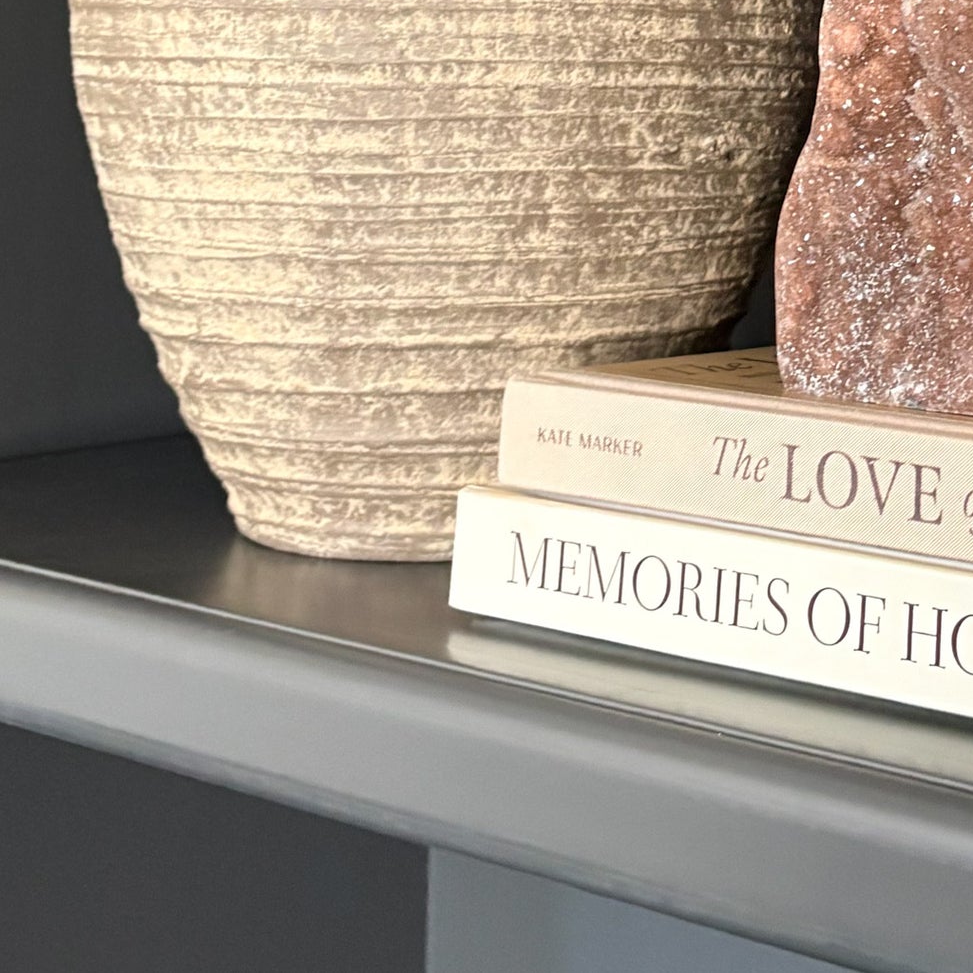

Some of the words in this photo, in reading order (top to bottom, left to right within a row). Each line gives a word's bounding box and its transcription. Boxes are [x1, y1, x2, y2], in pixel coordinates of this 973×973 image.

[651, 361, 753, 376] The
[537, 427, 574, 447] KATE
[579, 433, 643, 457] MARKER
[713, 435, 769, 483] The
[781, 444, 943, 525] LOVE
[507, 531, 790, 636] MEMORIES
[807, 587, 886, 654] OF
